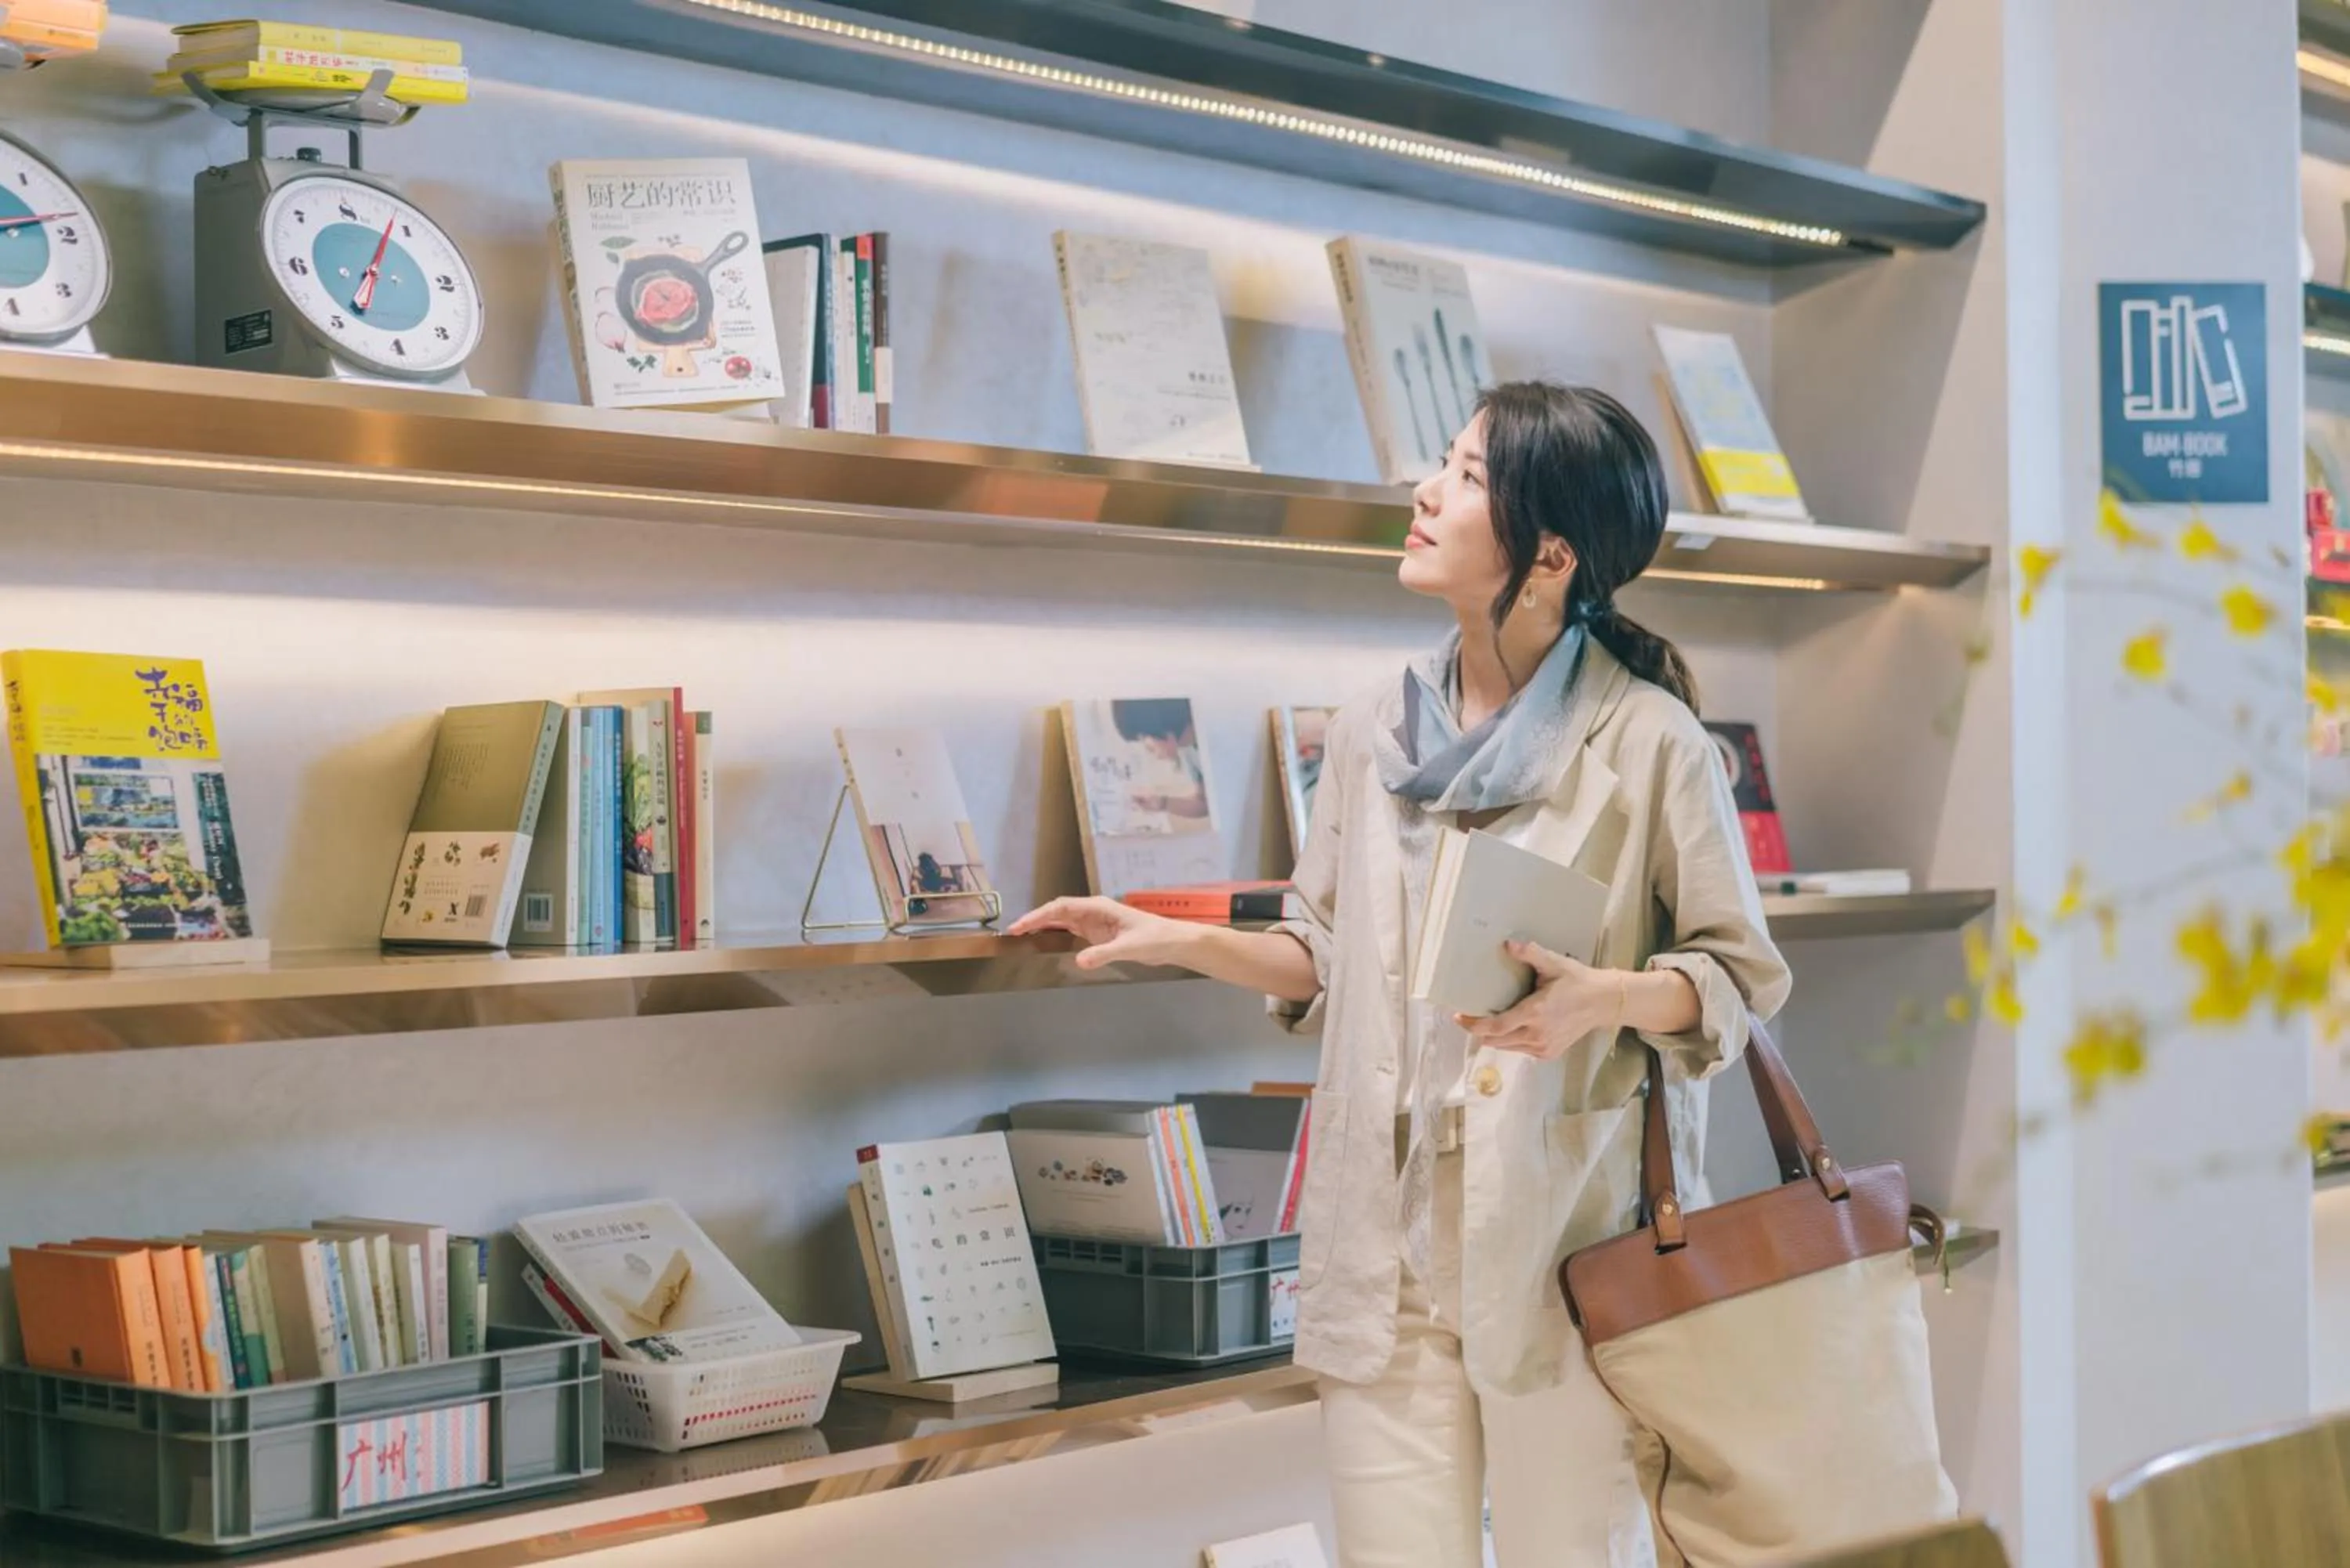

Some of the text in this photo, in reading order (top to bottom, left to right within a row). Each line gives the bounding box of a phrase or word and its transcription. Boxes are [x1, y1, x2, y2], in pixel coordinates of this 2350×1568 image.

[588, 179, 736, 209] 厨艺的常识
[57, 226, 78, 245] 2
[56, 283, 73, 298] 3
[436, 275, 455, 293] 2
[434, 326, 450, 341] 3
